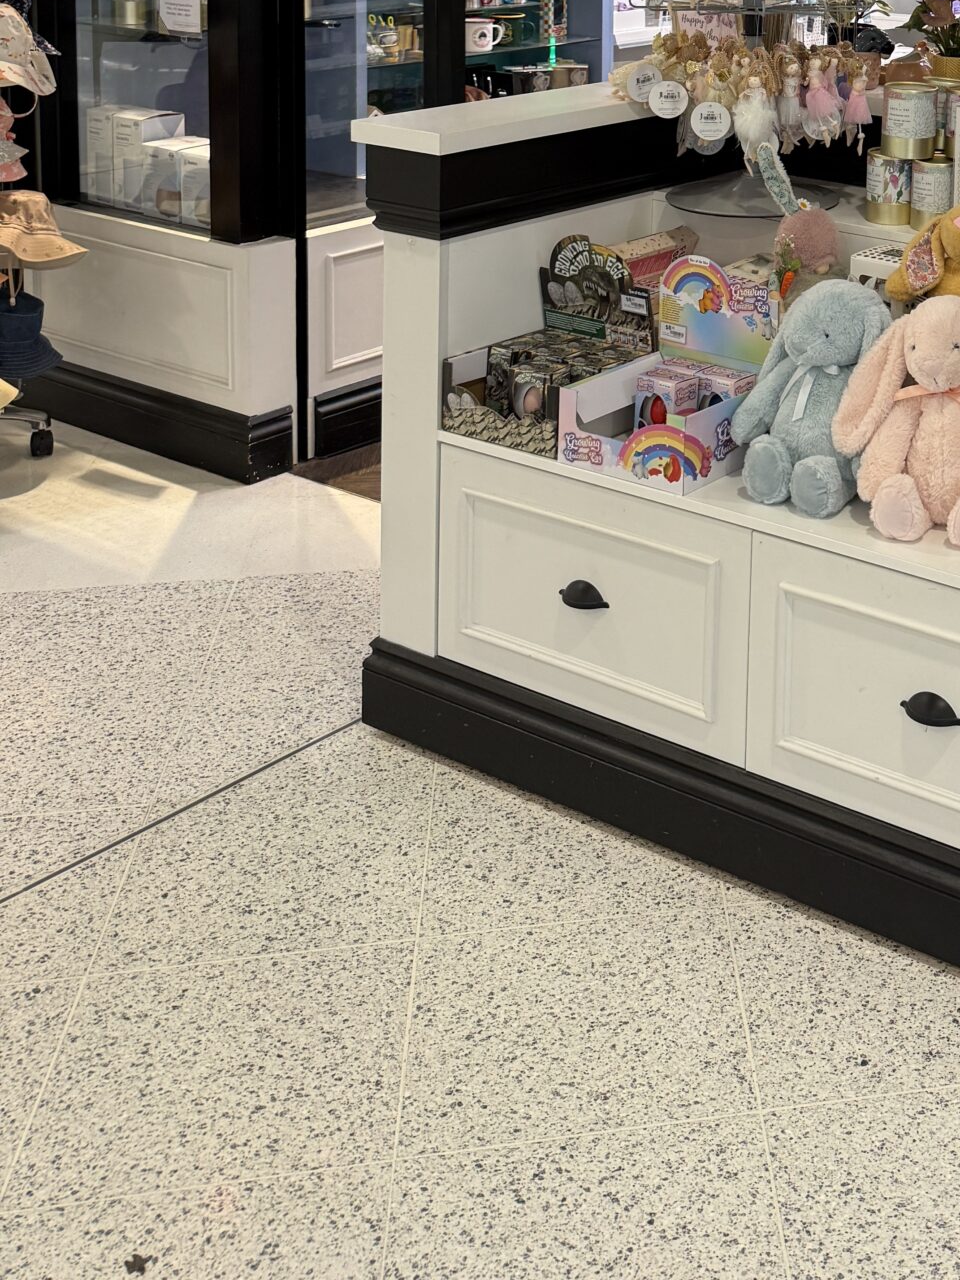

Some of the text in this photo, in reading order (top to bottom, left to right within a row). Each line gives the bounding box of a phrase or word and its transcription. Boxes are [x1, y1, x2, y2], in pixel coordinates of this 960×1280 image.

[554, 240, 589, 277] GROWING
[606, 256, 629, 280] EGG
[730, 283, 768, 300] Growing
[566, 433, 601, 451] Growing
